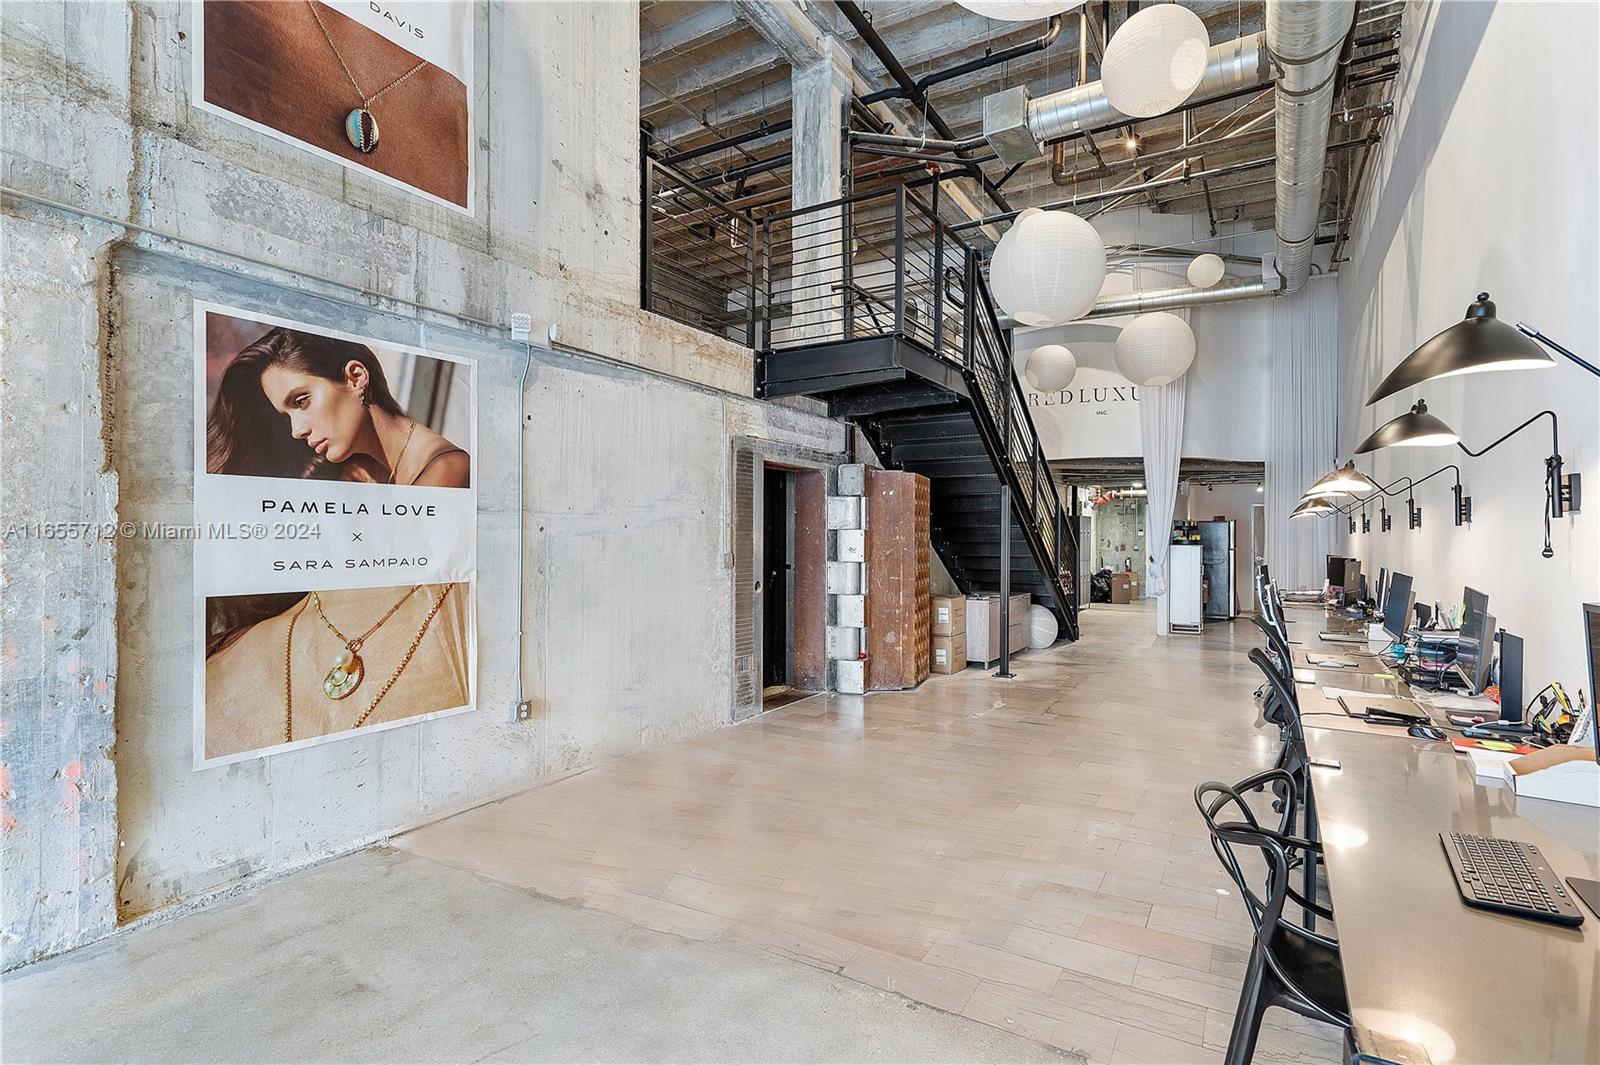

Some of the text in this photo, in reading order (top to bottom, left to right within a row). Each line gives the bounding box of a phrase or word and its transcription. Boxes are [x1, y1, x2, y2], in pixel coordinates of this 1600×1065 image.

[370, 1, 424, 39] DAVIS
[262, 499, 437, 517] PAMELA LOVE
[273, 557, 428, 571] SARA SAMPAIO
